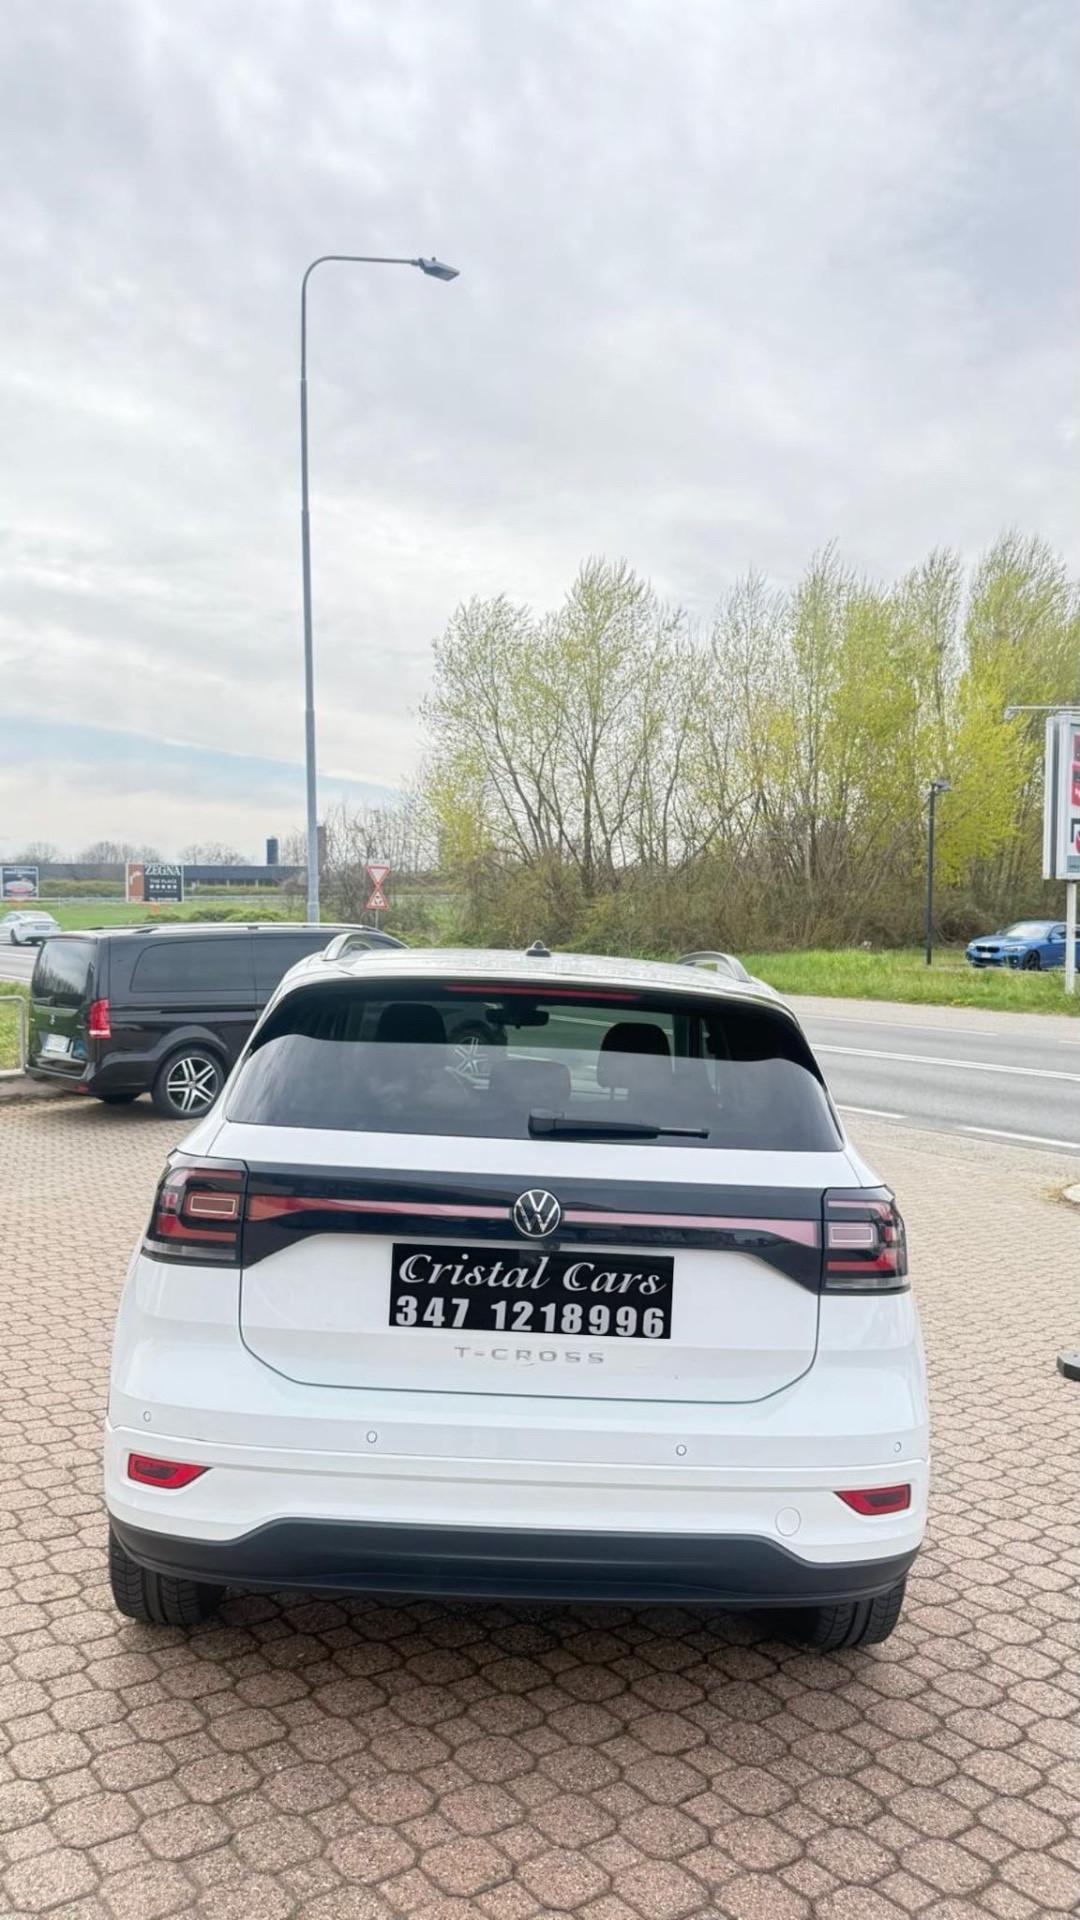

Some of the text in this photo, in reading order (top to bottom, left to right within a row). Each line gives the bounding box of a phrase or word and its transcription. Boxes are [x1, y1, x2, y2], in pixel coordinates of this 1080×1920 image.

[145, 864, 181, 876] ZEGNA
[399, 1253, 668, 1296] Cristal Cars
[395, 1295, 665, 1338] 347 1218996
[454, 1346, 605, 1364] T-CROSS
